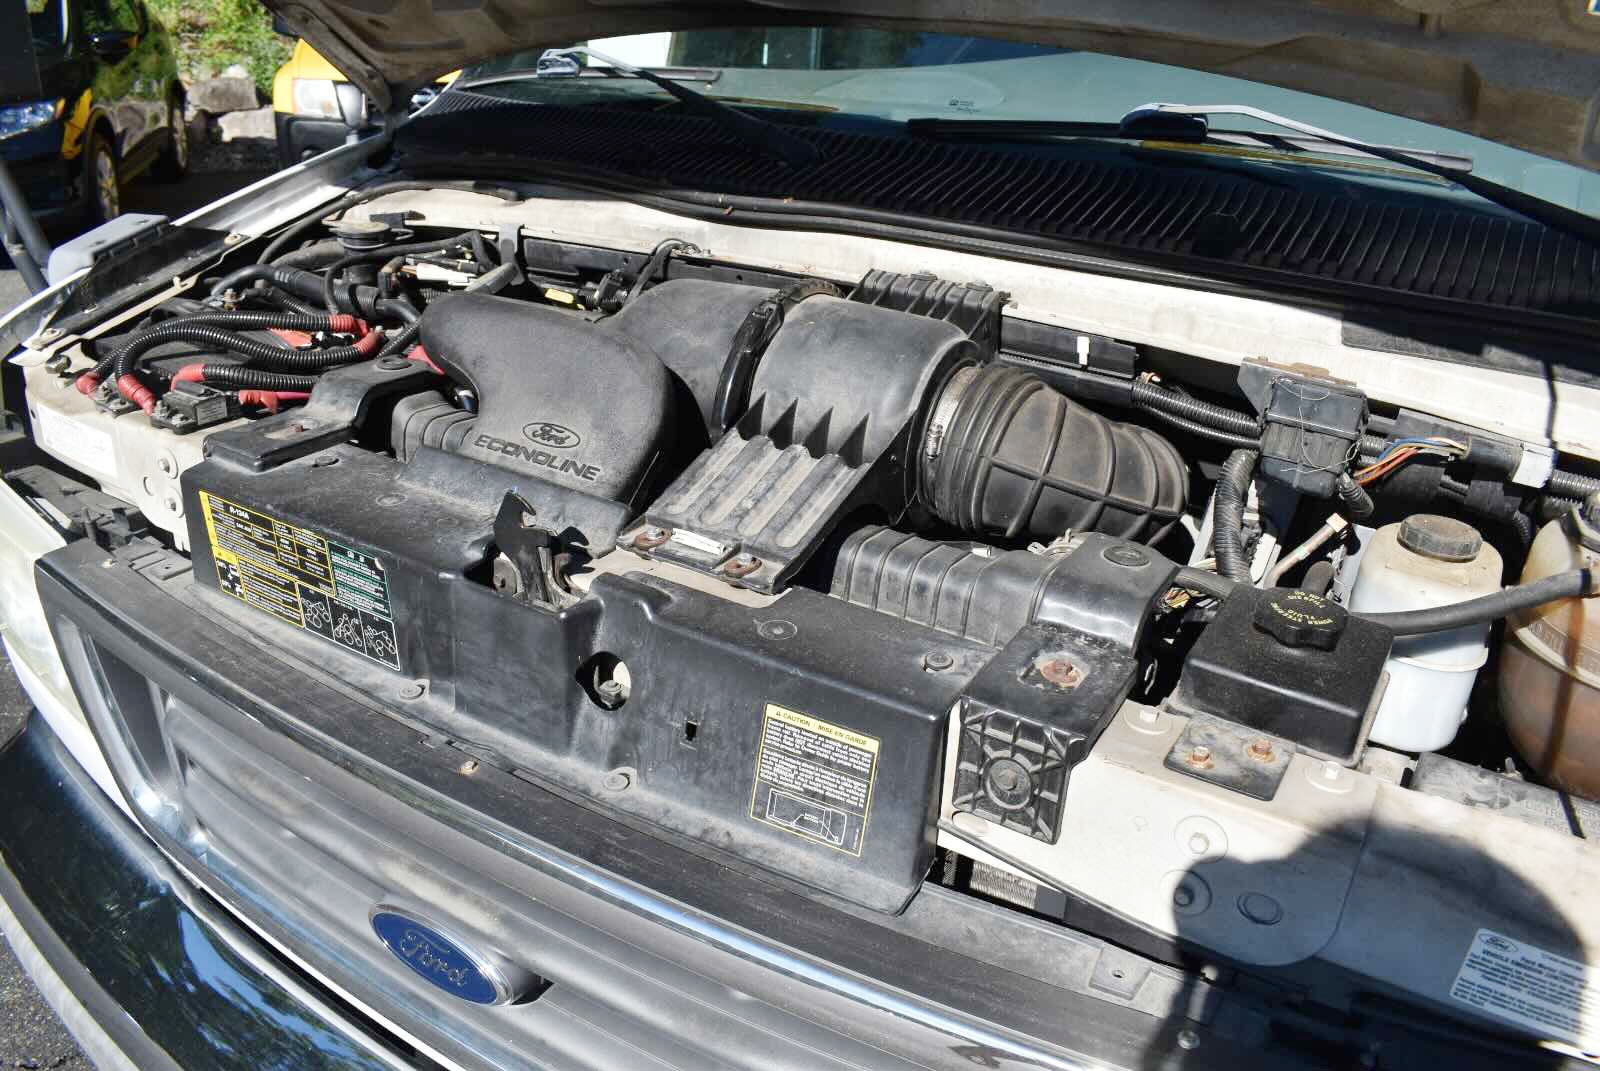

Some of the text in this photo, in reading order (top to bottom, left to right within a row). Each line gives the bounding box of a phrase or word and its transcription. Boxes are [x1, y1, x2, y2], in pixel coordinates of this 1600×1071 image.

[532, 423, 571, 445] Ford
[473, 434, 601, 481] ECONOLINE
[782, 712, 810, 726] CAUTION
[817, 724, 832, 734] MISE
[845, 734, 866, 746] GARDE
[400, 929, 468, 986] Ford
